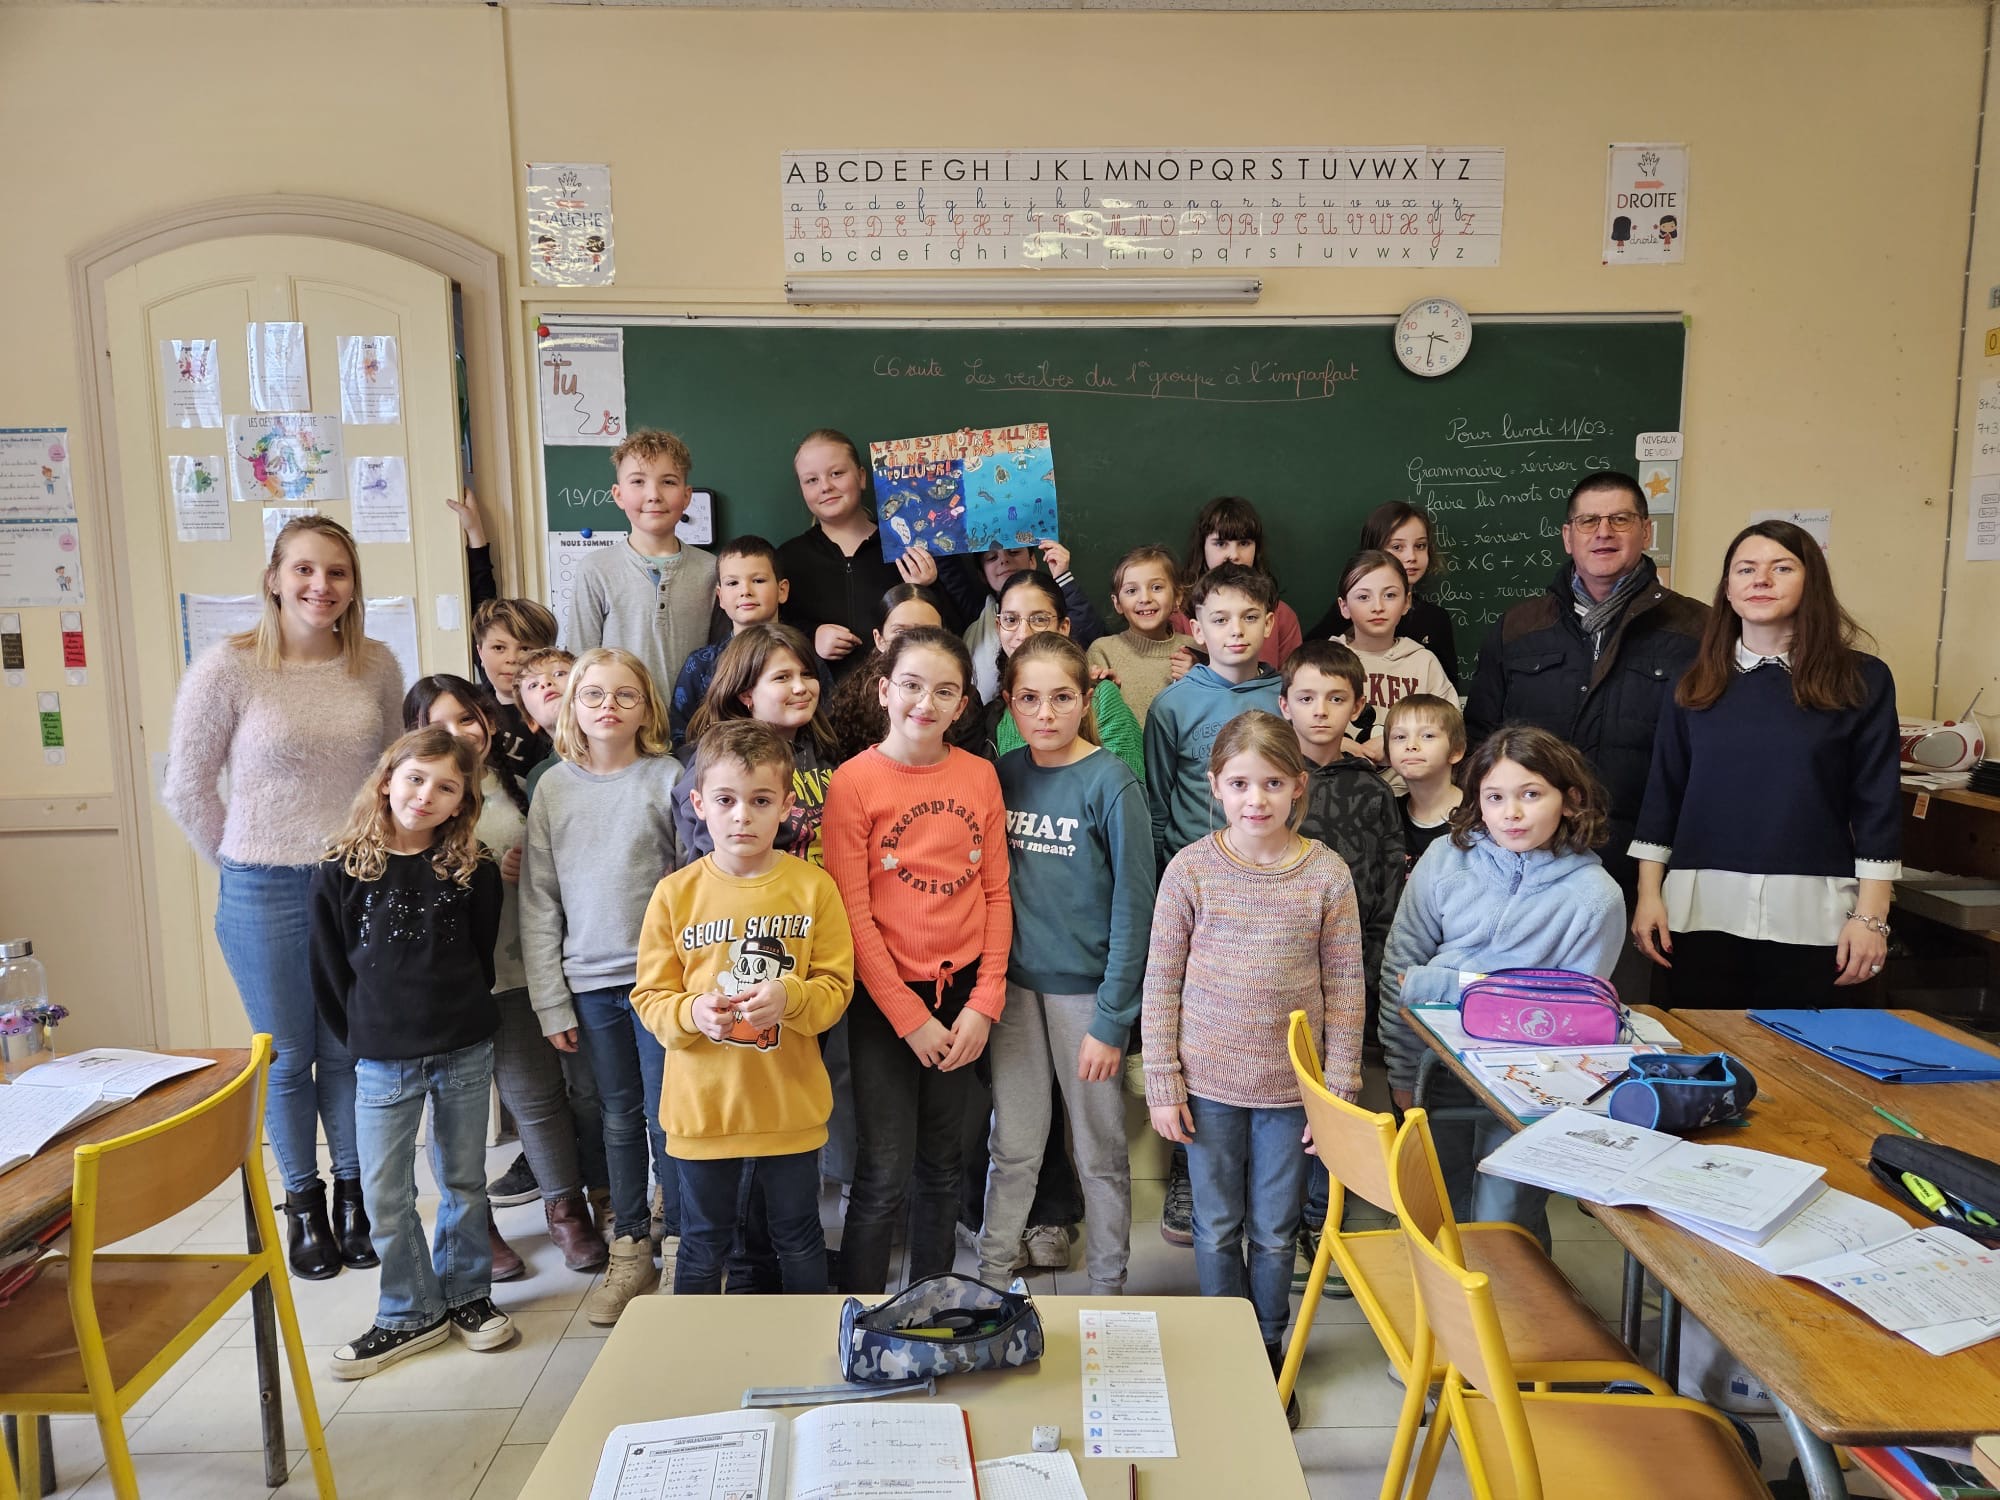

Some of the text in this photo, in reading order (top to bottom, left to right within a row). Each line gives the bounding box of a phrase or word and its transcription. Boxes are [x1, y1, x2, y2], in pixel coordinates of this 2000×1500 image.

[787, 158, 1470, 183] A B C D E F G H I J K L M N O P Q R S T U V W X Y Z
[1617, 193, 1676, 208] DROITE
[1630, 234, 1659, 245] droite
[794, 251, 804, 263] a
[822, 246, 832, 262] b
[848, 251, 857, 261] c
[871, 246, 881, 261] d
[898, 250, 908, 261] e
[925, 244, 930, 260] f
[950, 250, 960, 262] g
[978, 244, 986, 259] h
[1003, 246, 1006, 259] i
[1061, 243, 1068, 259] k
[1086, 243, 1089, 259] l
[1164, 248, 1173, 259] o
[1193, 248, 1202, 263] p
[1218, 248, 1228, 263] q
[1246, 247, 1251, 259] r
[1270, 248, 1276, 258] s
[1324, 247, 1332, 258] u
[1349, 248, 1358, 258] v
[1378, 248, 1389, 258] w
[1403, 247, 1410, 258] x
[1430, 247, 1438, 261] y
[1456, 248, 1463, 258] z
[1428, 305, 1440, 314] 12
[1406, 322, 1418, 330] 10
[1451, 319, 1459, 328] 2
[1406, 347, 1413, 355] 8
[544, 360, 578, 395] Tu
[964, 358, 996, 385] Les
[1005, 360, 1074, 387] verbes
[1085, 363, 1117, 388] du
[1225, 366, 1242, 385] à
[1251, 360, 1359, 400] l'imparfait
[1445, 417, 1491, 443] Pour
[1504, 414, 1553, 440] lundi
[1642, 436, 1676, 444] NIVEAUX
[1406, 457, 1506, 494] Grammaire
[1520, 451, 1578, 474] réviser
[1425, 483, 1542, 524] faire les mots
[1474, 523, 1532, 544] réviser
[560, 540, 581, 548] NOUS
[1447, 556, 1461, 572] à
[1420, 580, 1472, 605] nglais
[880, 798, 982, 850] Exemplaire
[1026, 842, 1076, 857] mean?
[897, 867, 974, 896] unique
[682, 914, 812, 950] SEOUL SKATER
